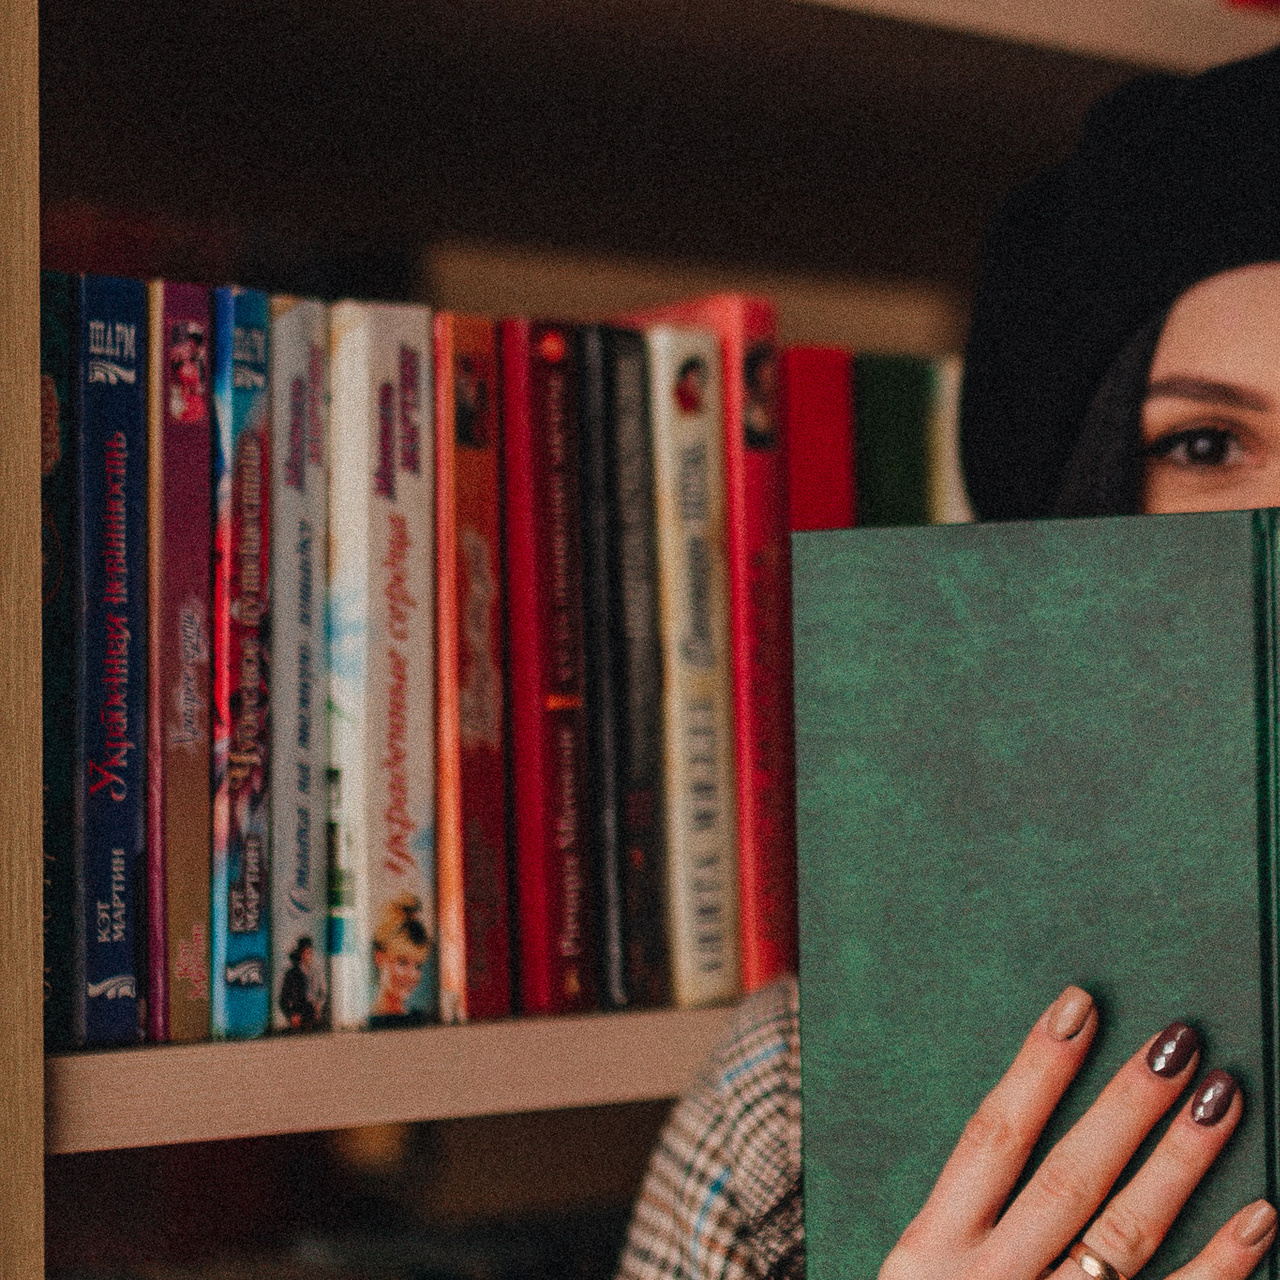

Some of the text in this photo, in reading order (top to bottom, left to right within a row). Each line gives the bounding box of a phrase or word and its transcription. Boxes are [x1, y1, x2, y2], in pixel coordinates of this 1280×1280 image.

[89, 320, 137, 359] ШАРМ
[89, 431, 137, 803] Украденная невинность
[297, 763, 312, 795] на
[112, 848, 127, 943] МАРТИН
[246, 835, 261, 932] МАРТИН
[97, 900, 112, 943] КЭТ
